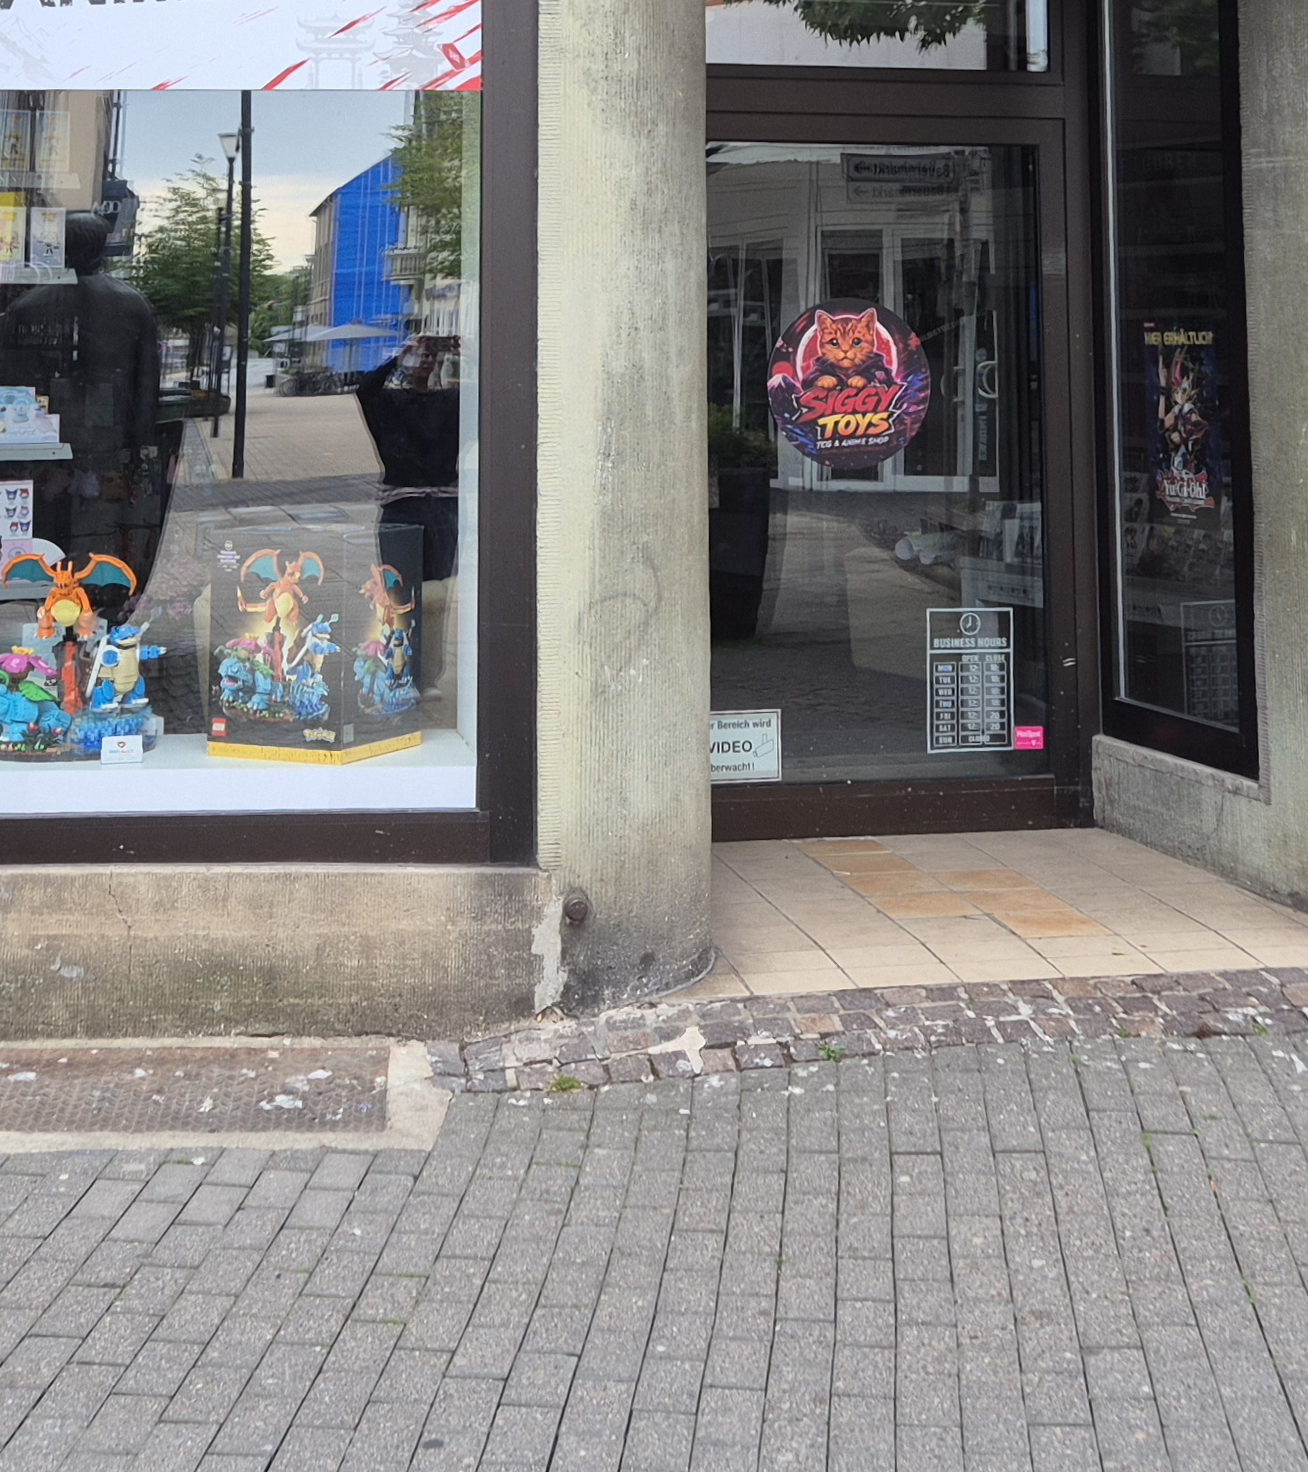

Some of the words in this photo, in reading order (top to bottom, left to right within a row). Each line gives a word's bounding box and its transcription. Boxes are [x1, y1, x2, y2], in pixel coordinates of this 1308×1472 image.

[796, 384, 903, 425] SIGGY
[817, 413, 892, 439] TOYS
[933, 638, 976, 648] BUSINESS
[978, 637, 1007, 647] HOURS
[717, 720, 750, 729] Bereich
[752, 719, 772, 728] wird
[710, 740, 753, 754] VIDEO
[710, 762, 755, 773] berwacht!
